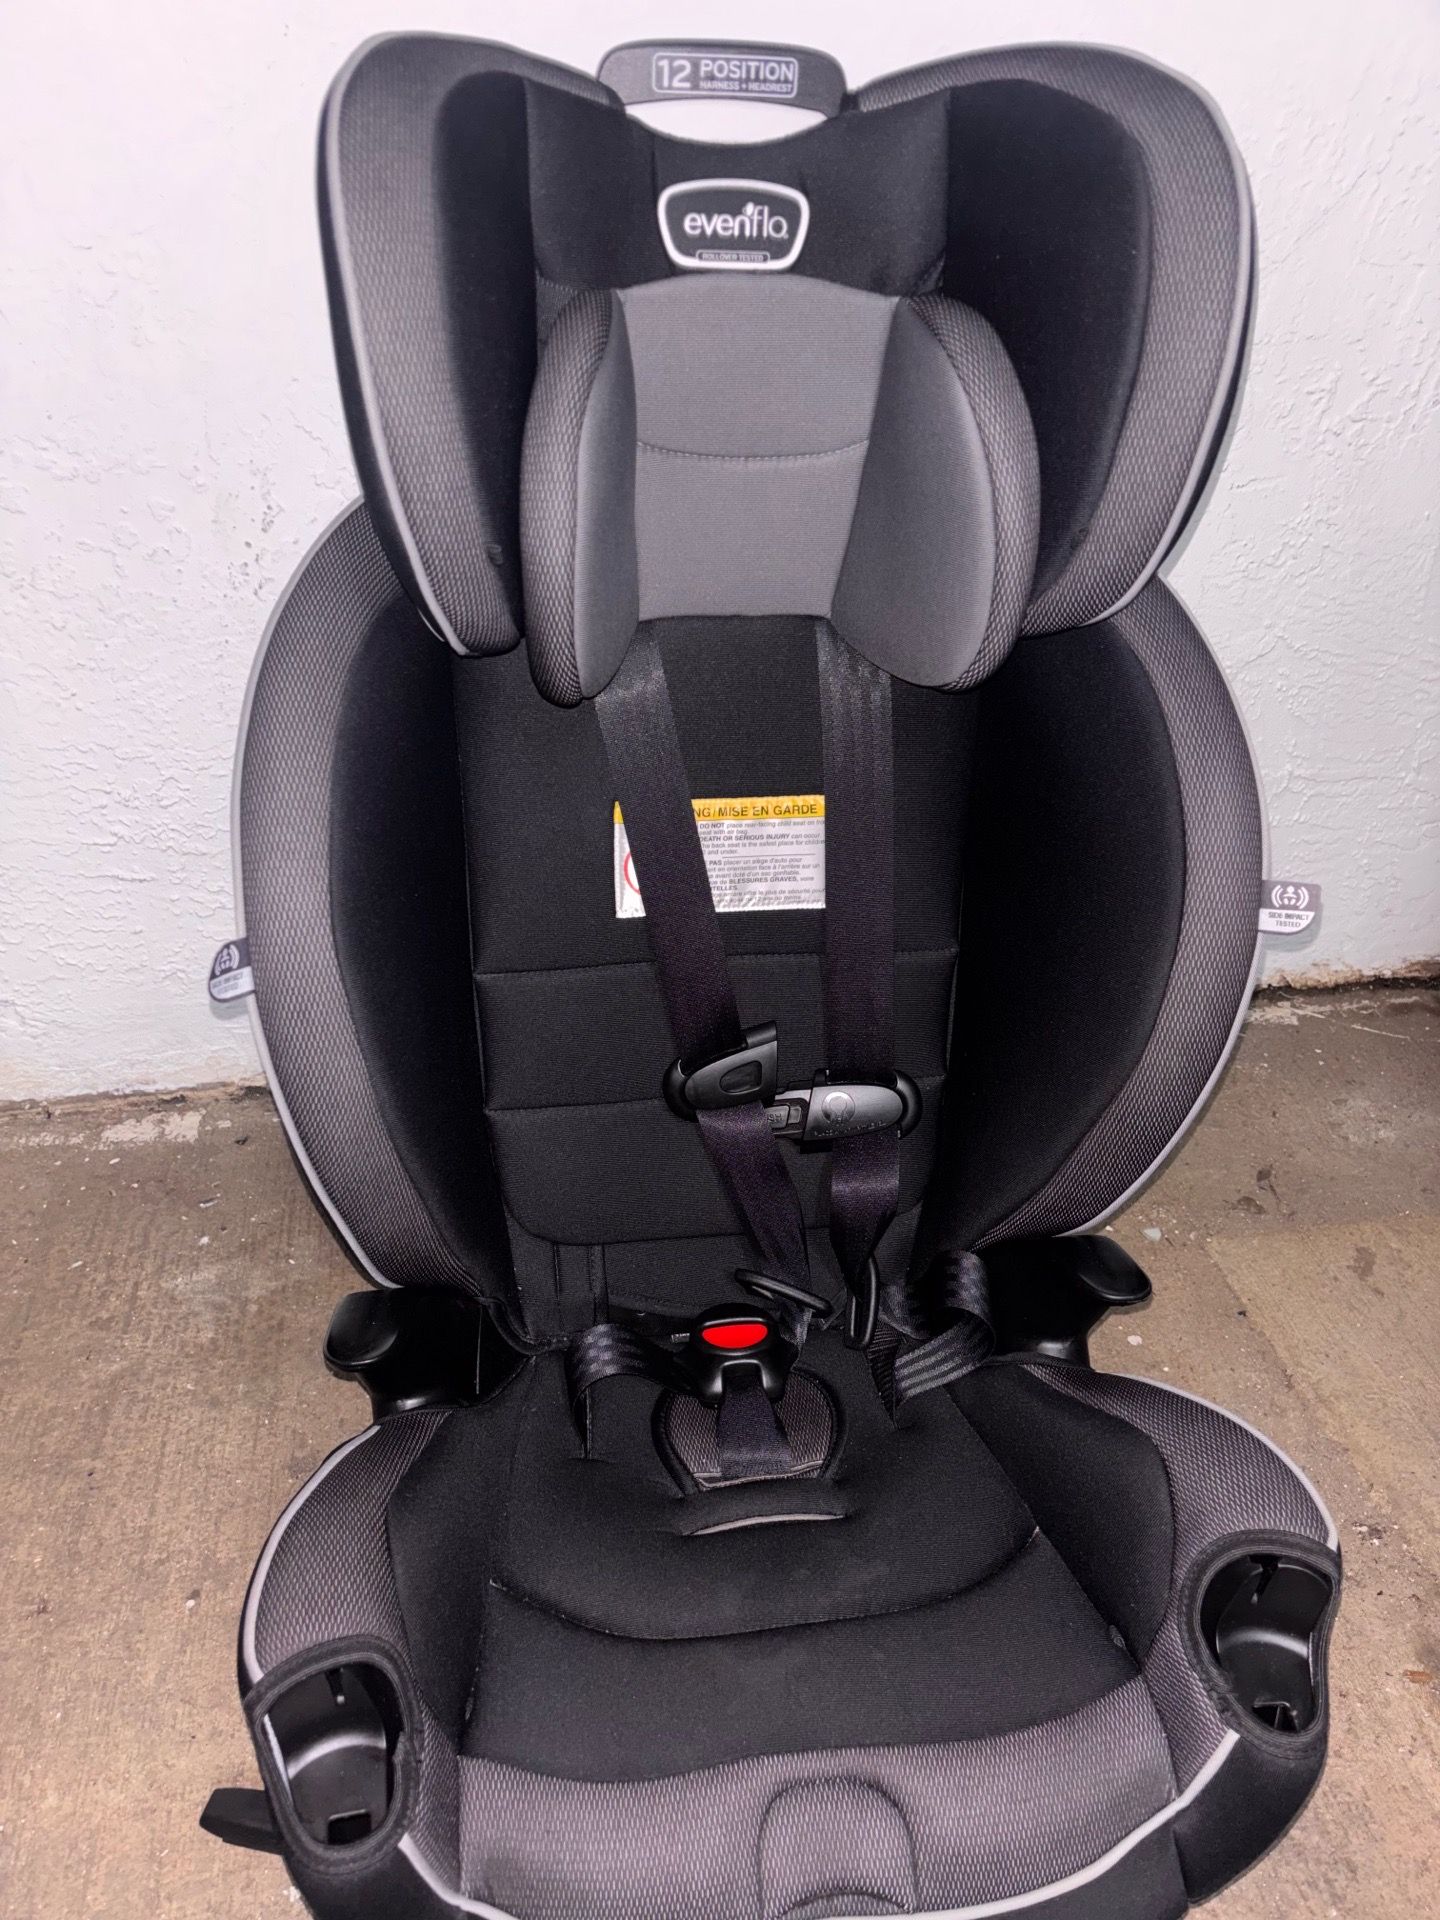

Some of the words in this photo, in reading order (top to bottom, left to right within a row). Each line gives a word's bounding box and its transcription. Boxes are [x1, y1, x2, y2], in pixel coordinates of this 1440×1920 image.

[657, 59, 692, 89] 12
[700, 59, 794, 82] POSITION
[699, 80, 740, 91] HARNESS
[748, 81, 793, 93] HEADREST
[683, 202, 789, 240] evenflo
[702, 252, 738, 262] ROLLOVER
[739, 253, 765, 263] TESTED
[752, 805, 769, 817] EN
[773, 803, 818, 816] GARDE
[734, 833, 765, 841] SERIOUS
[766, 832, 790, 840] INJURY
[728, 876, 769, 885] BLESSURES
